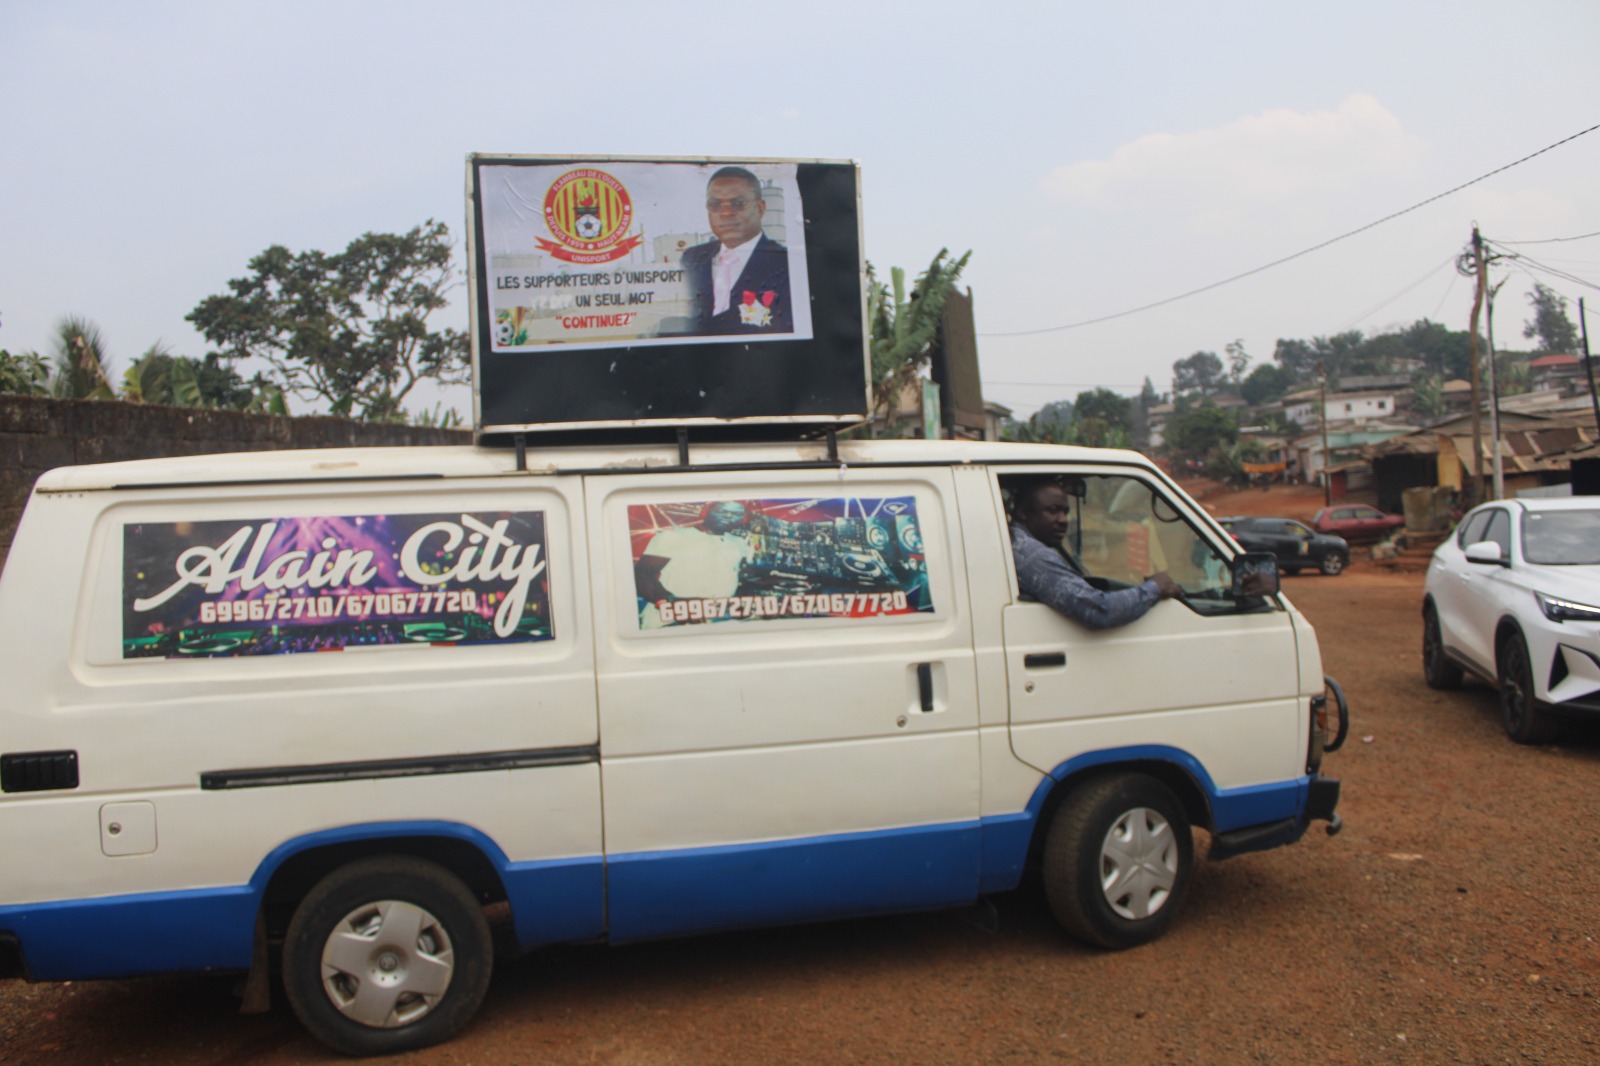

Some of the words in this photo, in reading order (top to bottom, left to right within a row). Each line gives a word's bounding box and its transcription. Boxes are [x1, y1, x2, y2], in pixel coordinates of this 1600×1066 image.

[547, 215, 566, 240] DEPUIS
[566, 237, 585, 249] 1959
[571, 253, 611, 262] UNISPORT
[496, 275, 520, 289] LES
[524, 272, 610, 288] SUPPORTEURS
[614, 270, 685, 285] D'UNISPORT
[575, 294, 591, 307] UN
[594, 293, 625, 307] SEUL
[628, 291, 655, 305] MOT
[555, 311, 638, 330] "CONTINUEZ"
[133, 521, 379, 613] Alain
[399, 513, 545, 639] City
[200, 590, 477, 624] 699672710/670677720
[659, 590, 908, 623] 699672710/670677720
